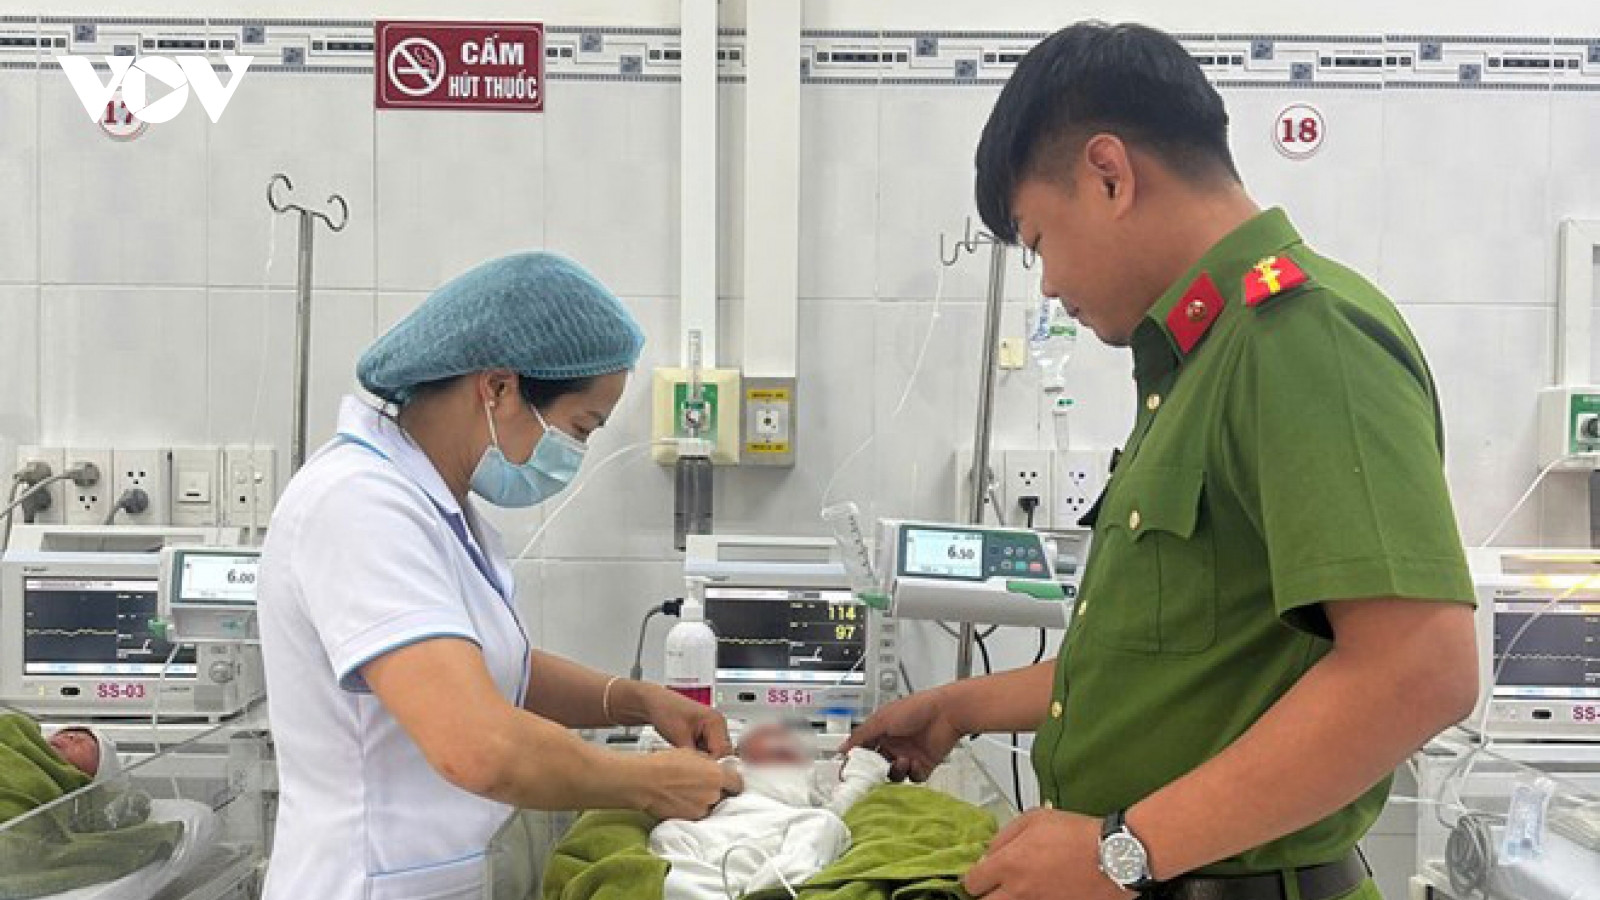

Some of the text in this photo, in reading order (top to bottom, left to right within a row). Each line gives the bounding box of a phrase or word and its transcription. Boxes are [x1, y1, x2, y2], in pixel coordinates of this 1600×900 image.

[462, 33, 525, 66] CẤM
[448, 69, 537, 99] HÚT THUỐC
[1282, 118, 1317, 142] 18
[827, 606, 857, 621] 114
[97, 683, 146, 698] SS-03
